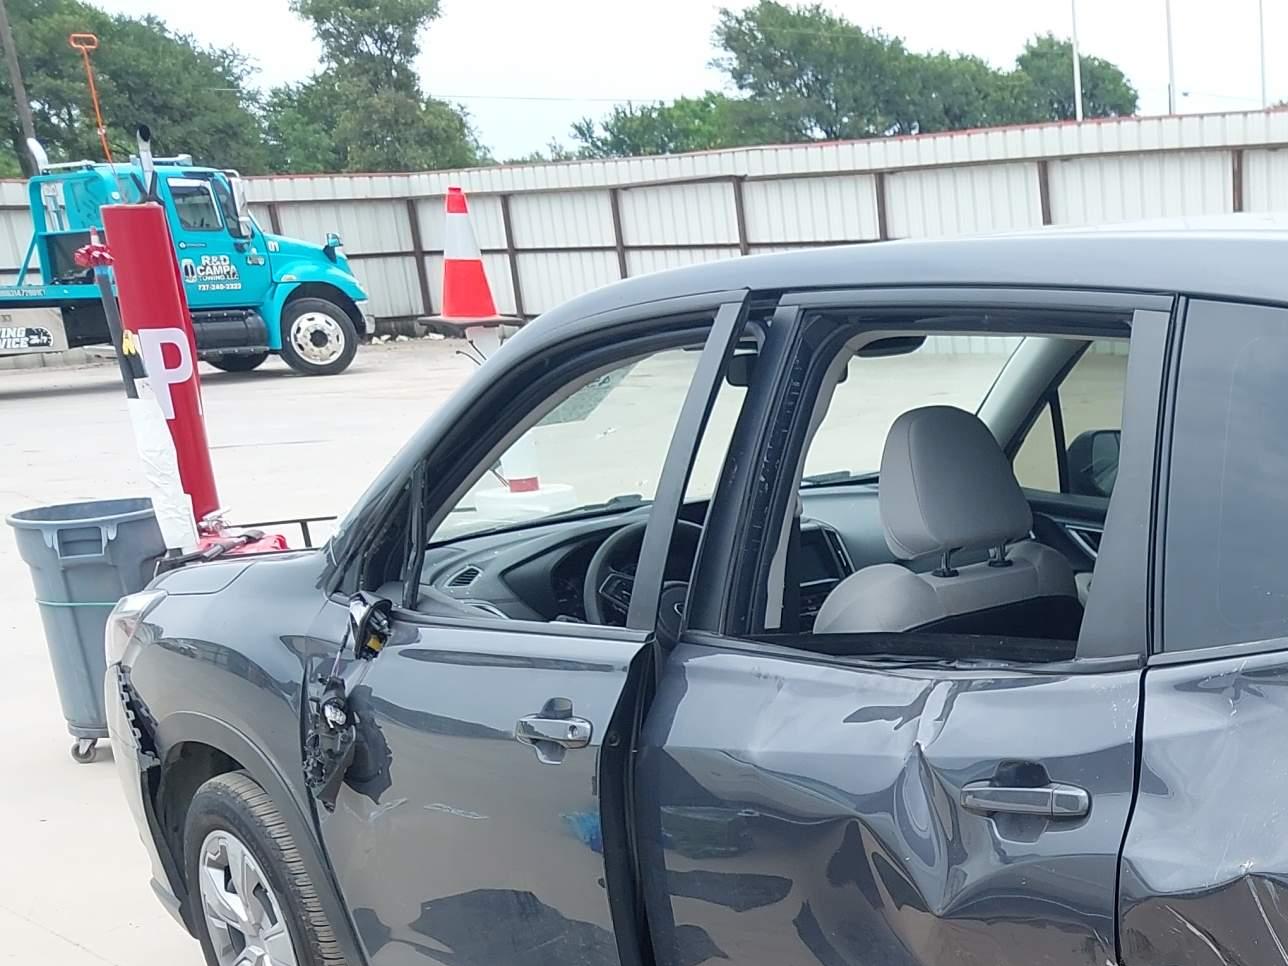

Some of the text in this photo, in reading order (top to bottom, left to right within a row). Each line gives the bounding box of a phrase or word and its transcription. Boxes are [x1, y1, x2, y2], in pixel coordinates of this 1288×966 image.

[201, 255, 229, 266] R&D
[197, 265, 238, 276] CAMPA
[0, 327, 26, 338] ING
[138, 328, 193, 419] P
